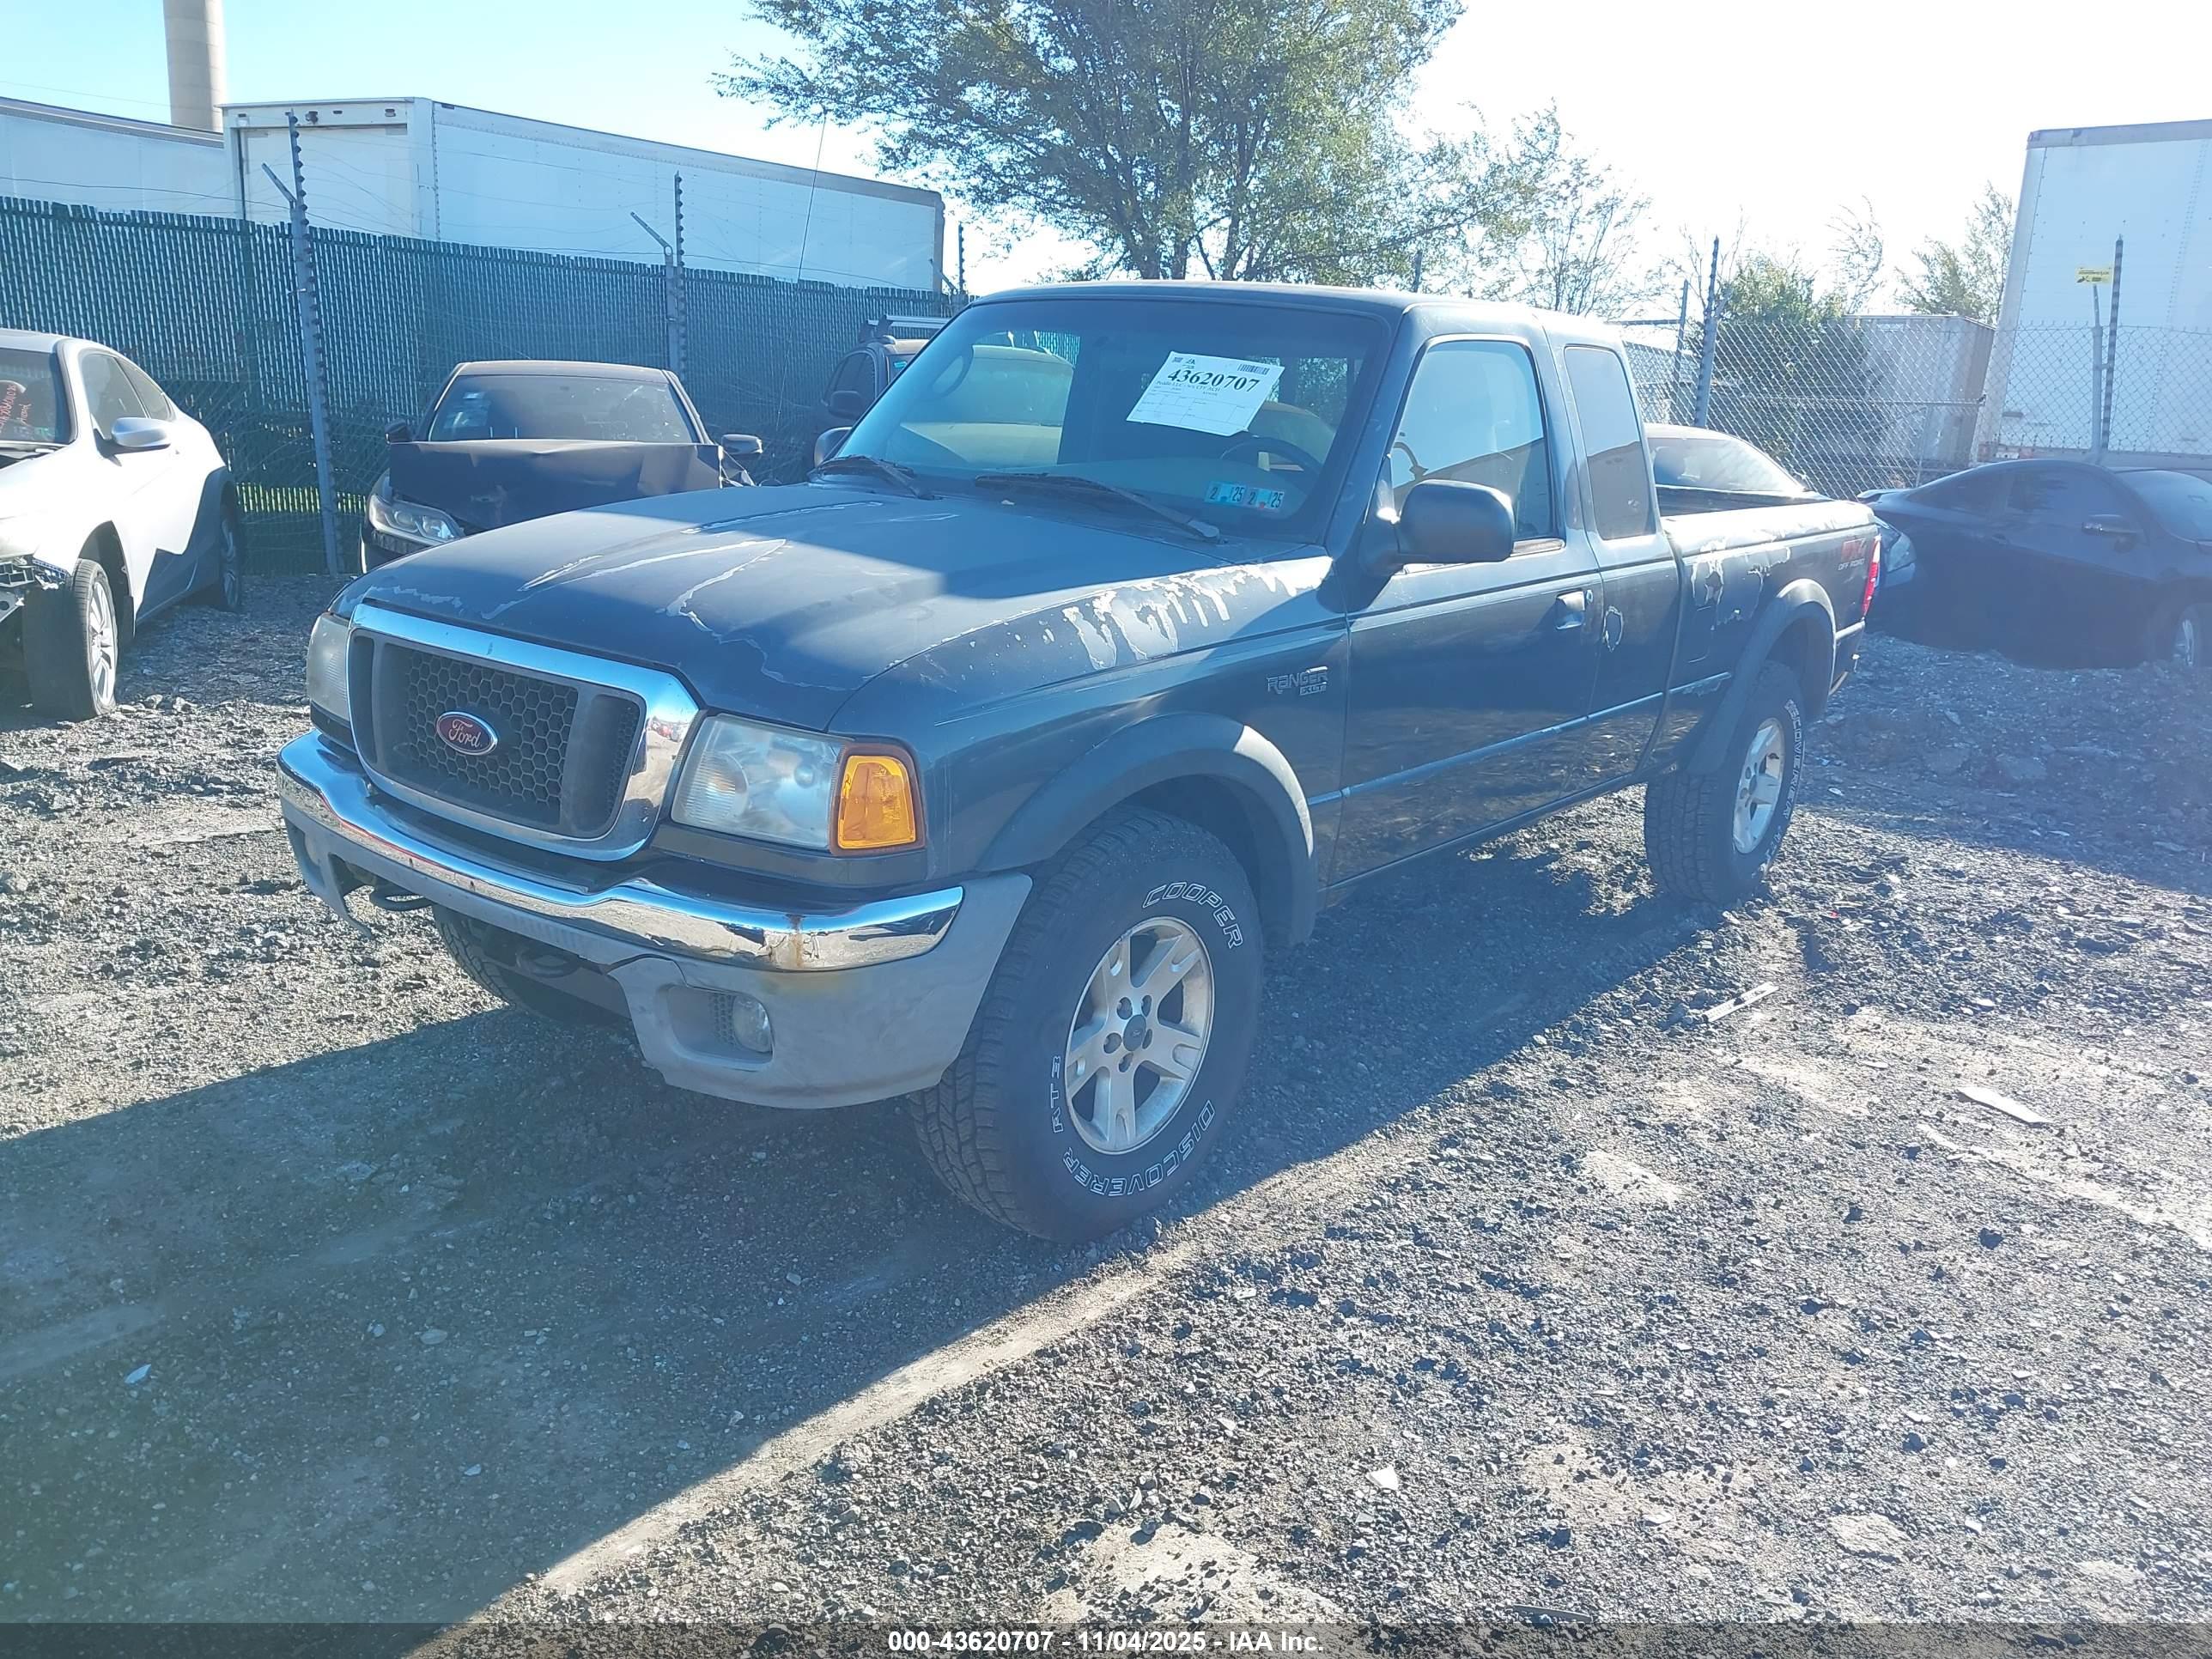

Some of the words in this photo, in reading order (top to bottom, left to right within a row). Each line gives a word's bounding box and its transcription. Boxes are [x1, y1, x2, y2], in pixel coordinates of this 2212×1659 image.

[1168, 369, 1260, 392] 43620707
[1210, 487, 1218, 501] 2
[1232, 486, 1245, 502] 25
[1271, 492, 1284, 508] 25
[448, 719, 482, 748] Ford
[1142, 881, 1243, 950] COOPER
[1062, 1099, 1216, 1197] DISCOVERER
